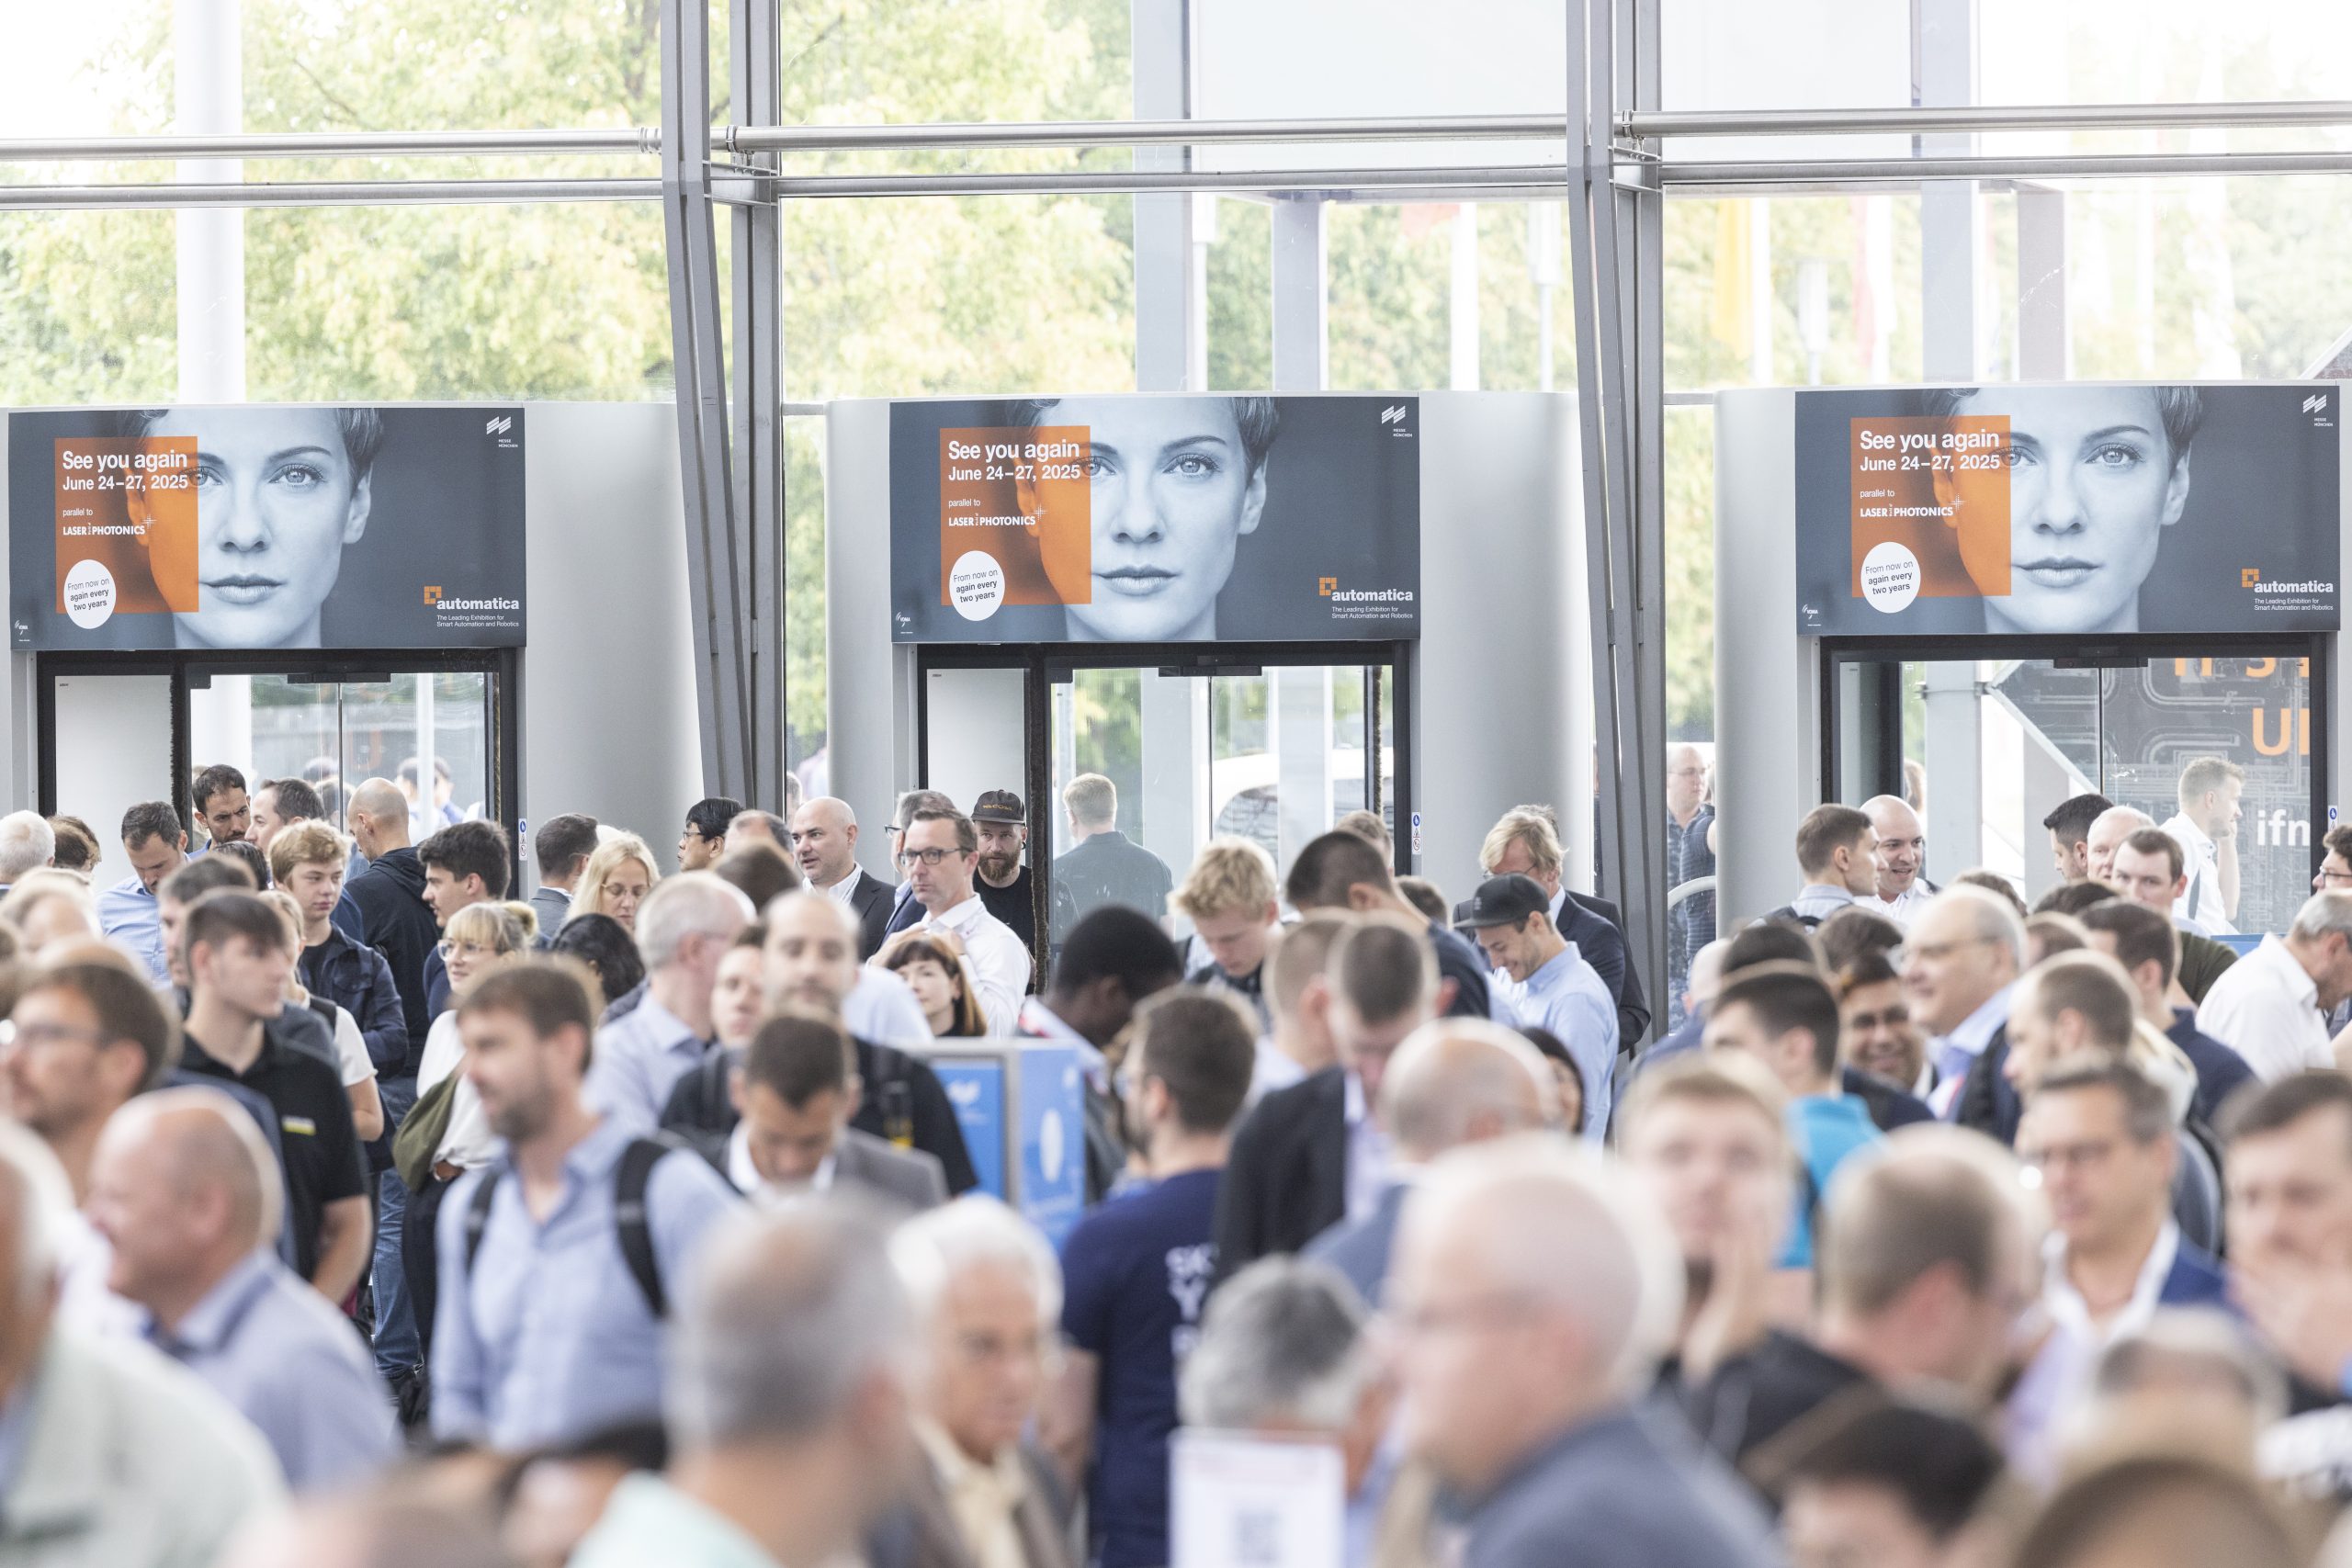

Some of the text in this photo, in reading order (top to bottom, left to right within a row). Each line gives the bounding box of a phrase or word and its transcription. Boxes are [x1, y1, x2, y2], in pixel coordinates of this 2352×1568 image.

[1860, 429, 1999, 453] See you again
[949, 439, 1080, 463] See you again
[63, 449, 187, 473] See you again
[1860, 457, 1896, 471] June
[1960, 455, 2000, 469] 2025
[949, 467, 981, 481] June
[1042, 465, 1080, 479] 2025
[63, 477, 94, 490] June
[151, 475, 188, 489] 2025
[1860, 489, 1885, 499] parallel
[949, 499, 971, 508] parallel
[63, 508, 85, 518] parallel
[1860, 508, 1888, 517] LASER
[1894, 507, 1954, 516] PHOTONICS
[949, 517, 974, 526] LASER
[979, 516, 1036, 526] PHOTONICS
[63, 526, 87, 535] LASER
[92, 526, 145, 535] PHOTONICS
[1865, 566, 1884, 574] From
[1868, 572, 1912, 585] again every
[956, 580, 997, 594] again every
[1888, 584, 1910, 594] years
[2254, 580, 2333, 593] automatica
[70, 589, 109, 602] again every
[975, 592, 995, 602] years
[1332, 589, 1413, 601] automatica
[88, 599, 107, 610] years
[437, 597, 519, 609] automatica
